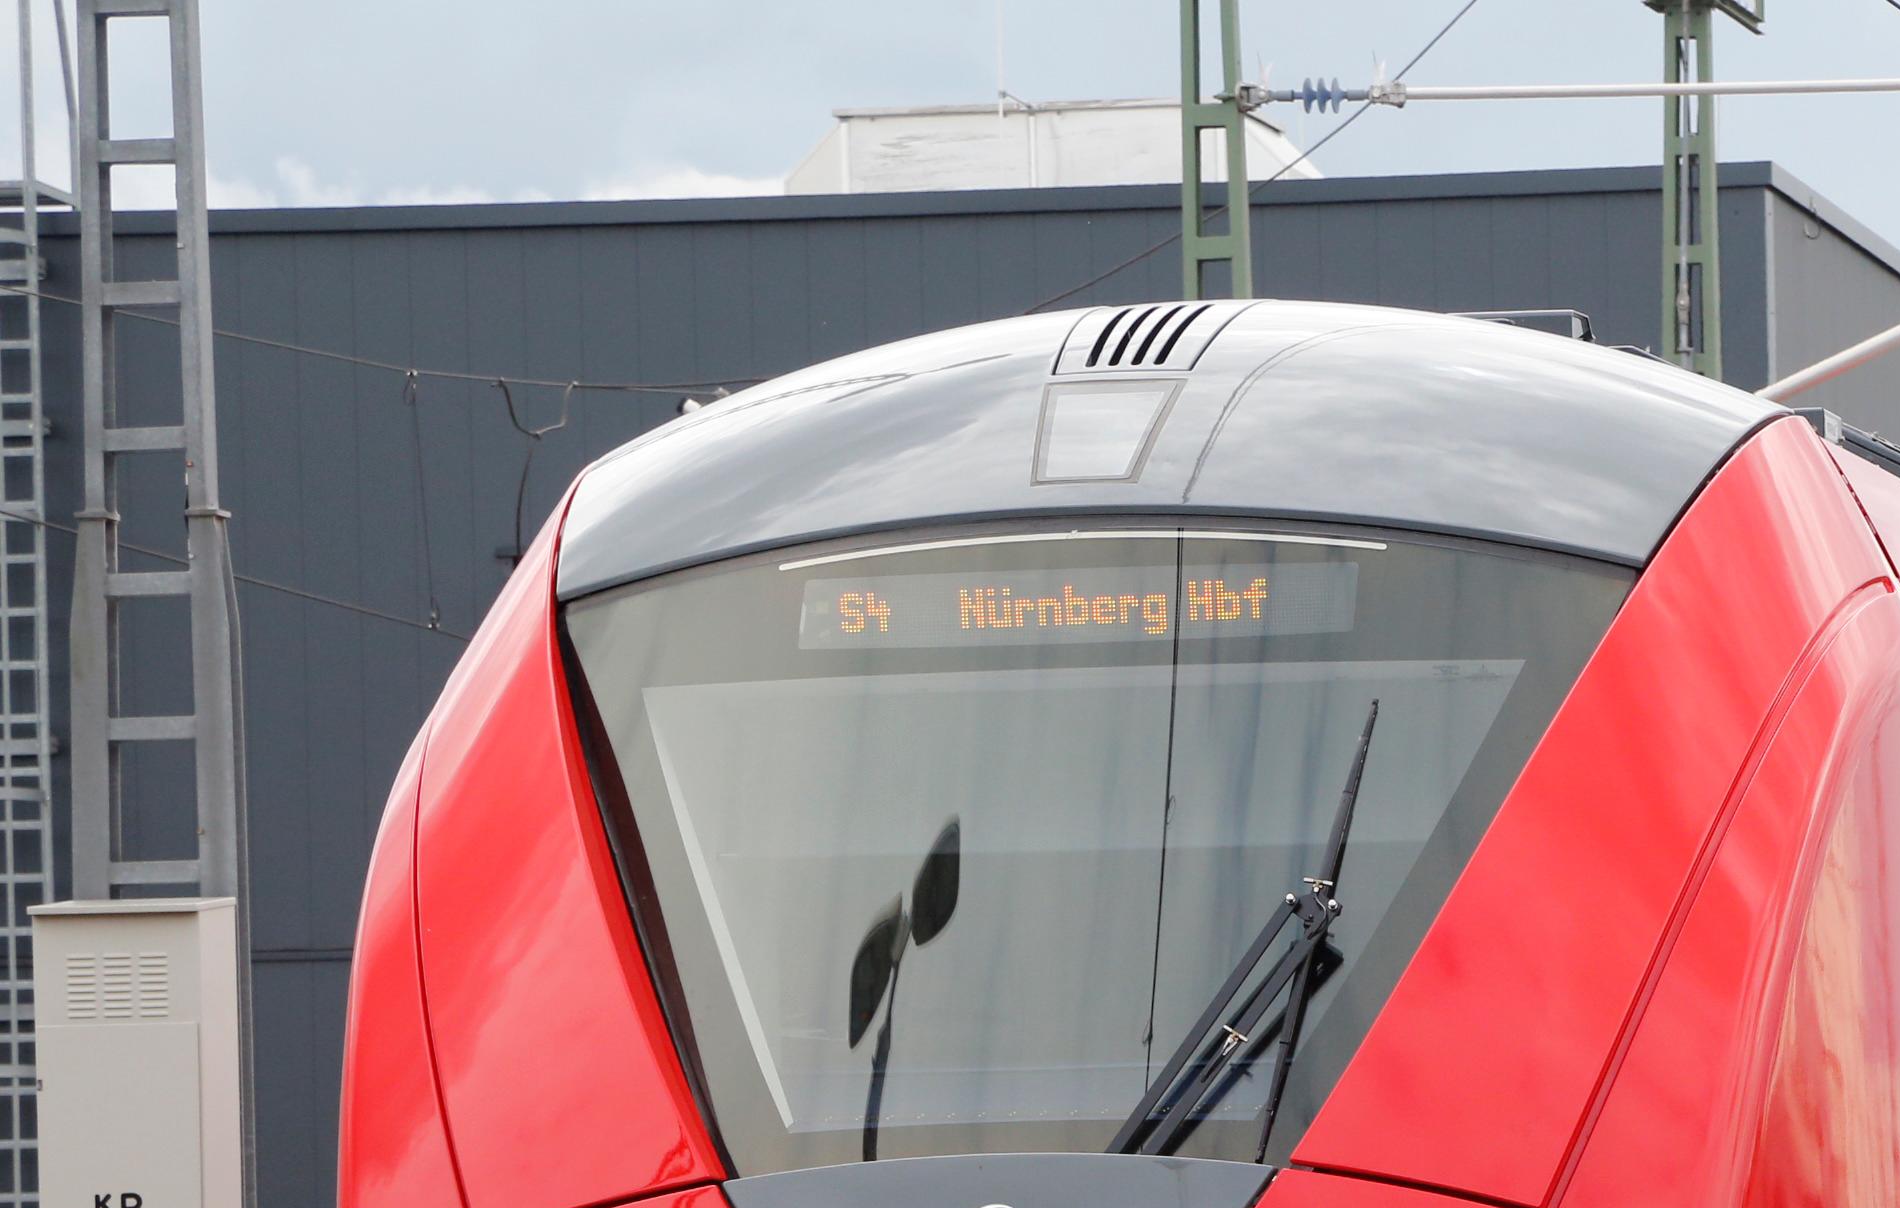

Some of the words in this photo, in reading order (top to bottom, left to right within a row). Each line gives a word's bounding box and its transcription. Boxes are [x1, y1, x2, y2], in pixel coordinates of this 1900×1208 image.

[839, 591, 892, 633] S4
[959, 584, 1168, 635] Nürnberg
[1188, 577, 1268, 622] Hbf
